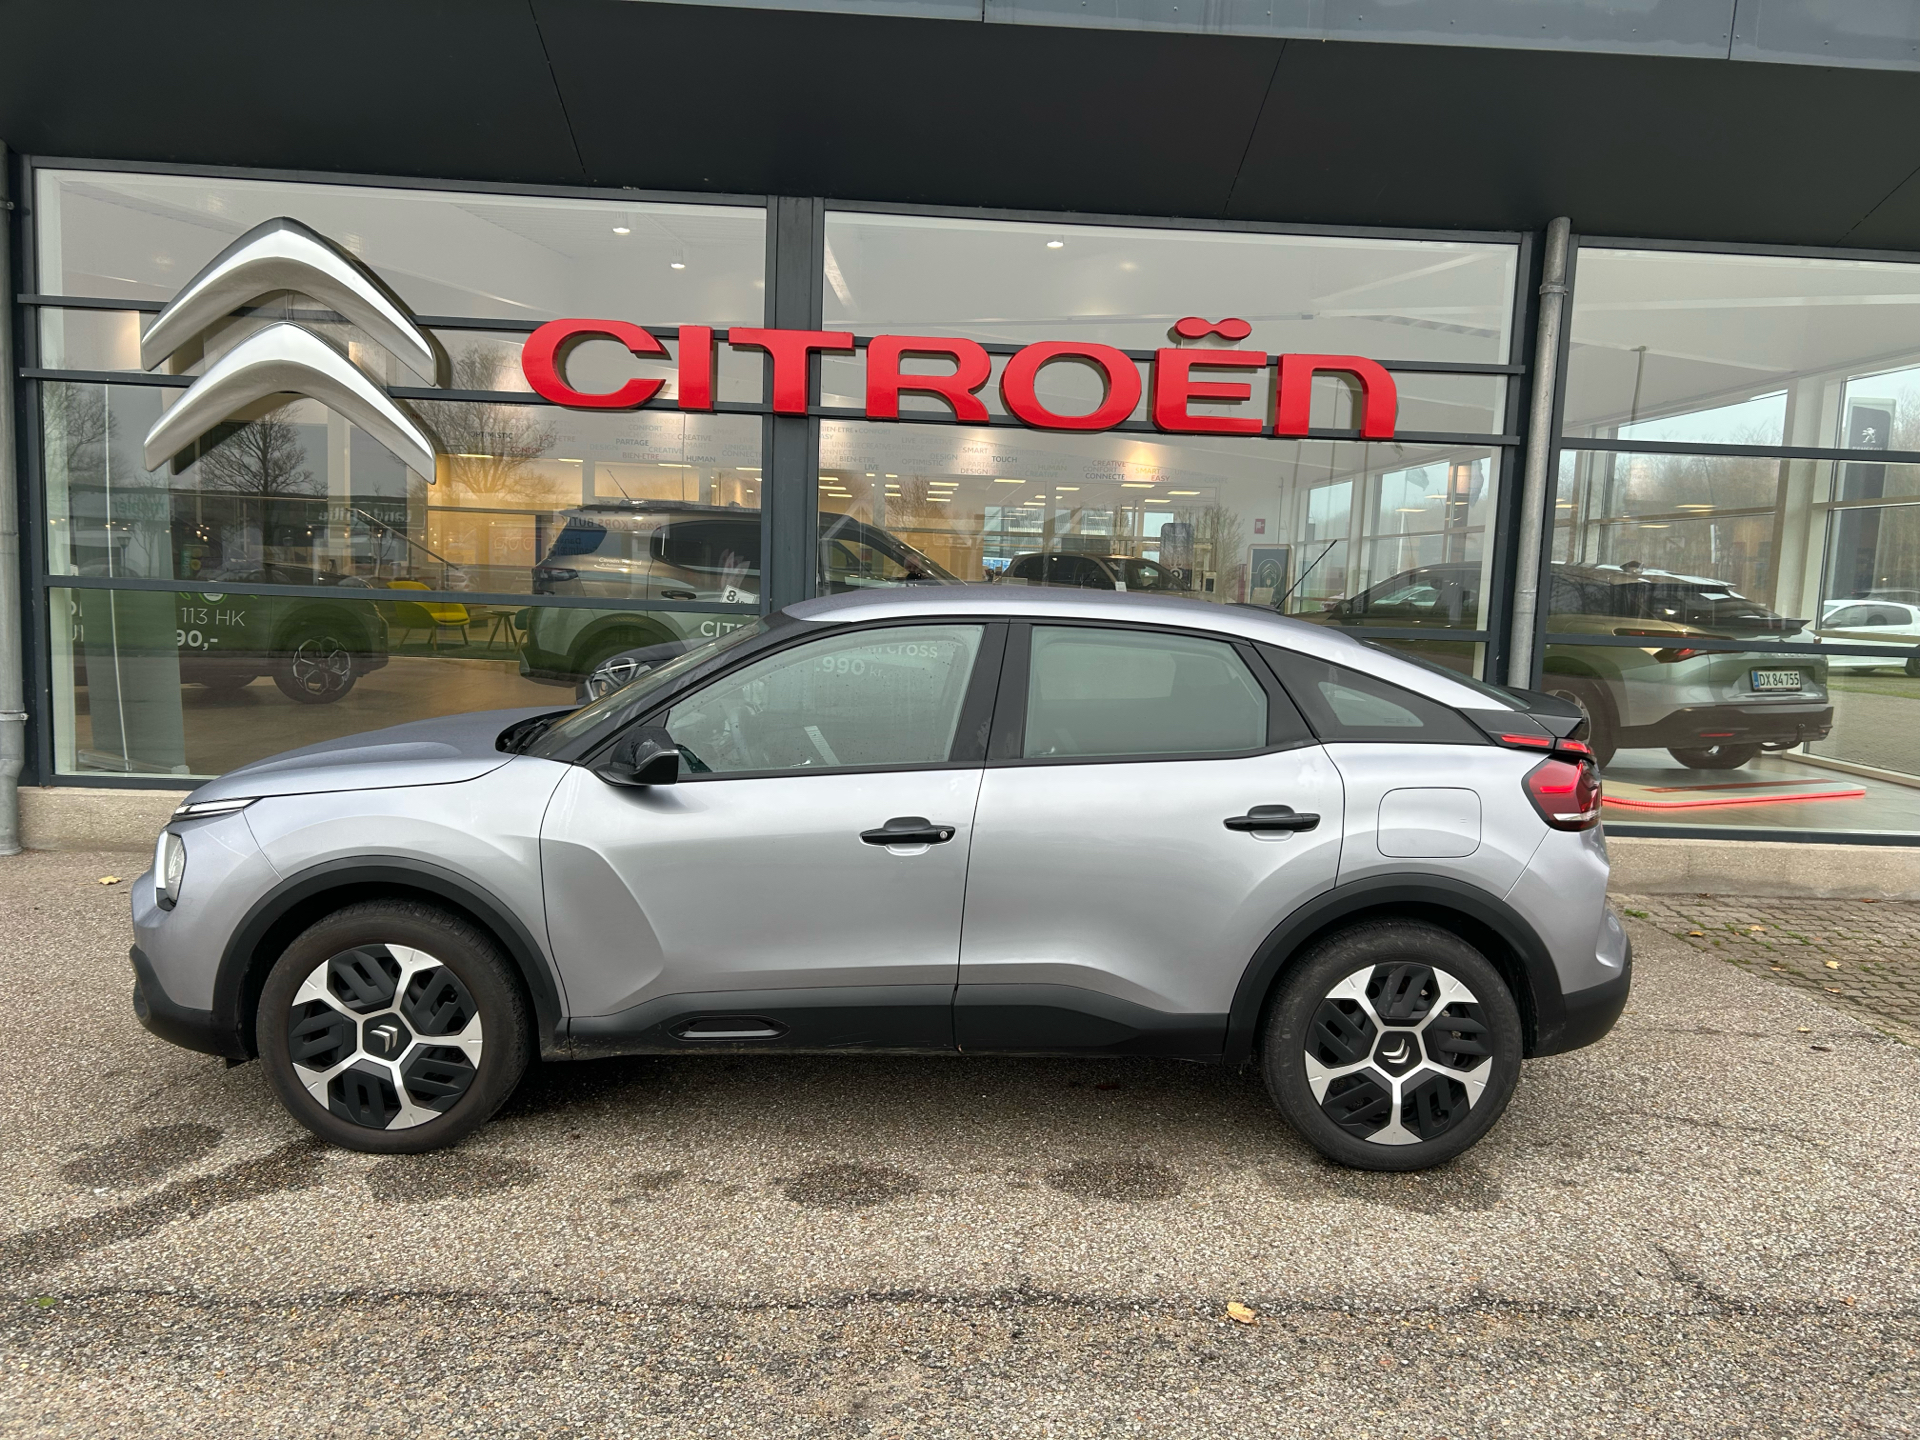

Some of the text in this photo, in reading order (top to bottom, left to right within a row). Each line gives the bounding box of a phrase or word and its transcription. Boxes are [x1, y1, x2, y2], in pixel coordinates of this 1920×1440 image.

[629, 424, 663, 432] CONFORT
[677, 433, 712, 442] CREATIVE
[615, 438, 649, 447] PARTAGE
[962, 446, 989, 455] SMART
[622, 451, 660, 461] BIEN-ETRE
[686, 455, 716, 463] HUMAN
[839, 455, 876, 464] BIEN-ETRE
[930, 453, 958, 461] DESIGN
[991, 455, 1018, 463] TOUCH
[864, 463, 880, 471] LIVE
[902, 458, 944, 467] OPTIMISTIC
[1091, 459, 1127, 468] CREATIVE
[961, 467, 988, 476] DESIGN
[1037, 464, 1068, 472] HUMAN
[1083, 465, 1117, 473] CONFORT
[1135, 467, 1161, 475] SMART
[1024, 470, 1059, 478] CREATIVE
[1151, 474, 1171, 482] EASY
[181, 608, 245, 628] 113 HK
[700, 620, 744, 638] CIT
[1759, 673, 1771, 686] DX
